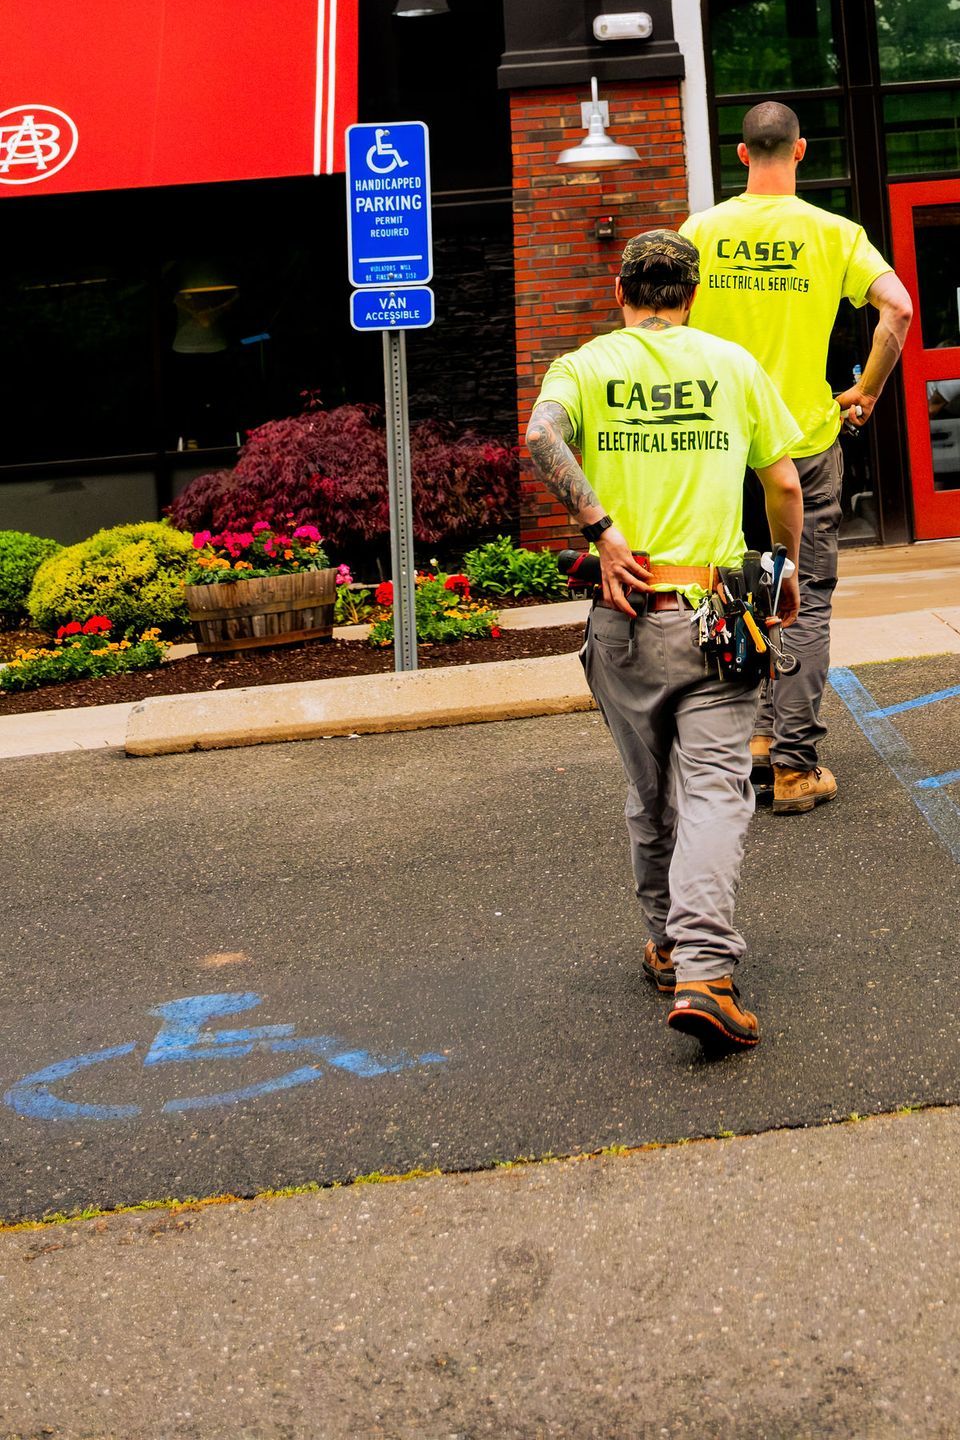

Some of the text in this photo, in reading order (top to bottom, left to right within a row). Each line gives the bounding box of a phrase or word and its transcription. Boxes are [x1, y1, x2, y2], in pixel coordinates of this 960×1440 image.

[355, 177, 421, 191] HANDICAPPED
[356, 195, 422, 213] PARKING
[375, 215, 404, 225] PERMIT
[370, 227, 409, 237] REQUIRED
[717, 239, 805, 261] CASEY
[709, 274, 809, 292] ELECTRICAL SERVICES
[379, 296, 407, 309] VAN
[365, 310, 420, 321] ACCESSIBLE
[606, 379, 719, 411] CASEY
[598, 430, 729, 453] ELECTRICAL SERVICES
